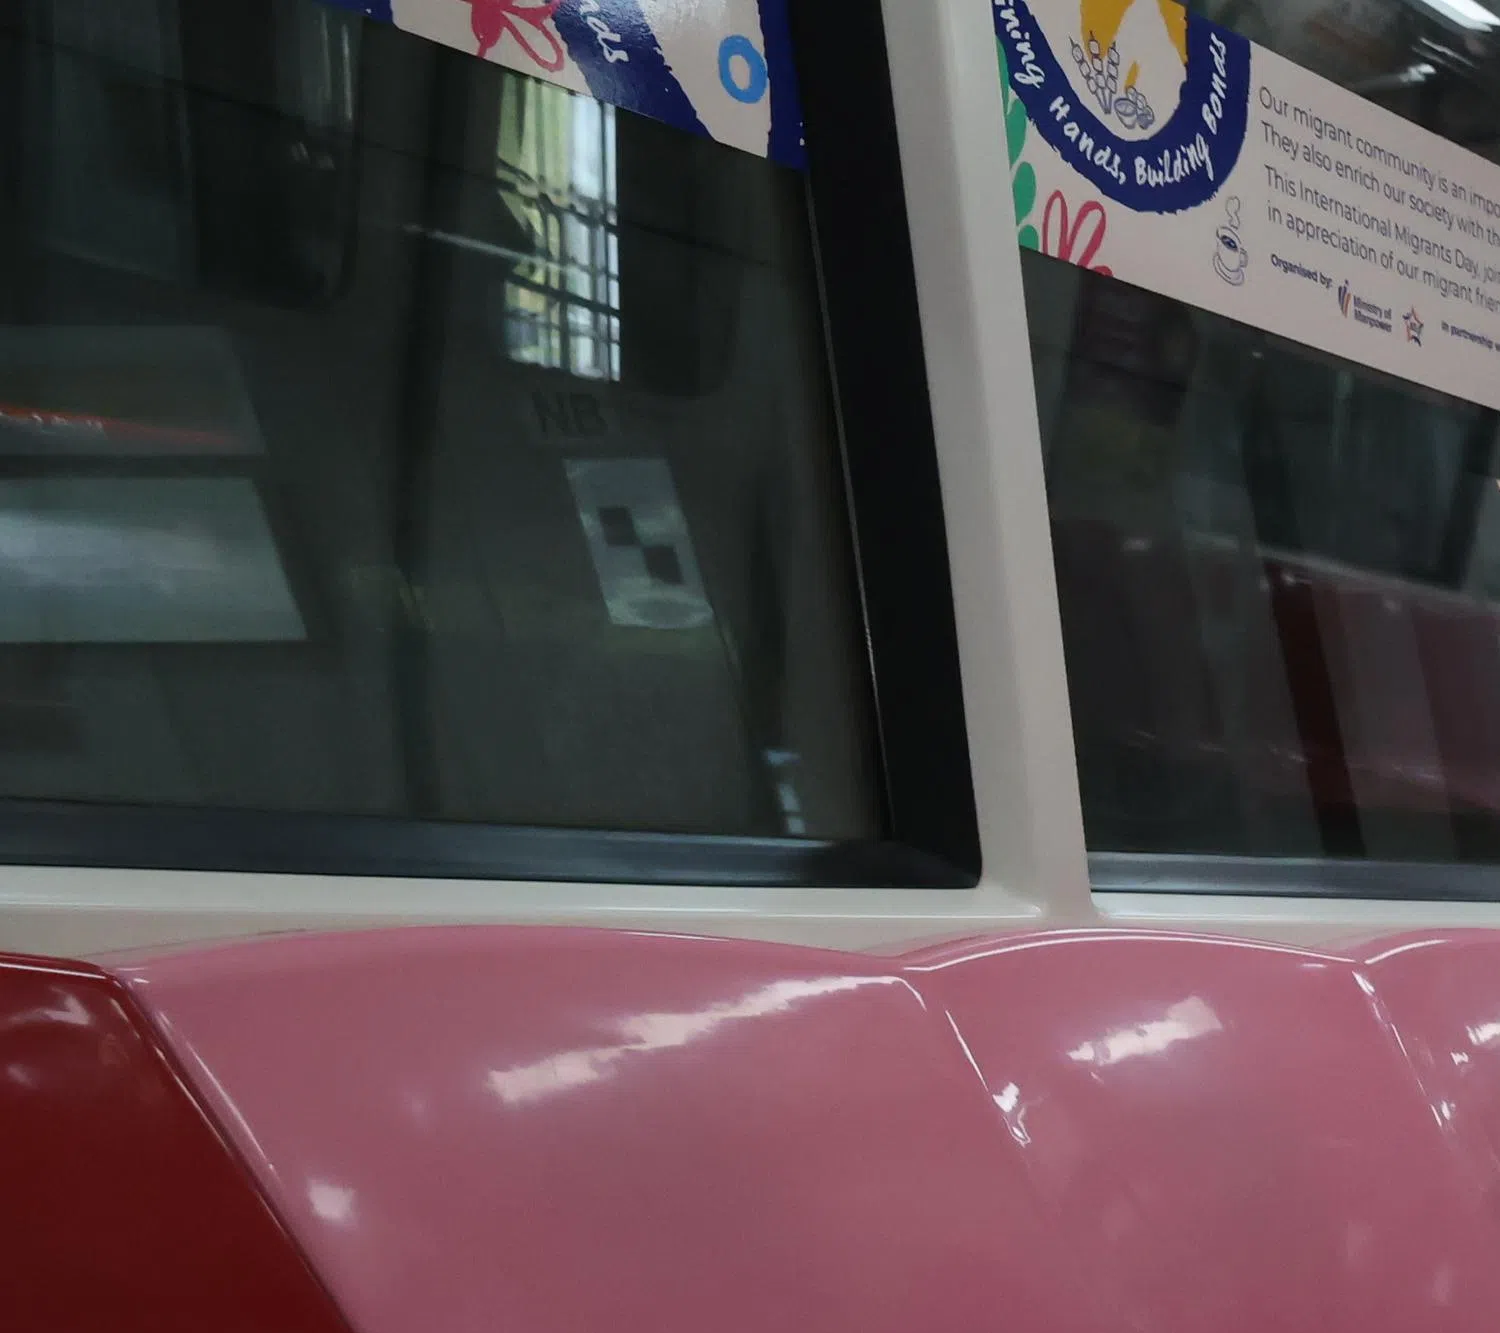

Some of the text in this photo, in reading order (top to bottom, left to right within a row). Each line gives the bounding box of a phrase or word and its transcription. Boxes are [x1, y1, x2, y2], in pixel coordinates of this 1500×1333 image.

[1050, 96, 1126, 185] Hands,
[1134, 133, 1214, 188] Building
[1202, 32, 1227, 135] Bonds
[1259, 86, 1289, 117] Our
[1293, 107, 1353, 149] migrant
[1356, 137, 1435, 191] community
[1438, 176, 1449, 194] is
[1451, 182, 1467, 201] an
[1261, 120, 1299, 161] They
[1302, 144, 1332, 172] also
[1336, 161, 1380, 193] enrich
[1383, 183, 1406, 205] our
[1409, 193, 1455, 231] society
[1457, 216, 1484, 240] with
[1264, 164, 1296, 198] This
[1300, 180, 1392, 237] International
[1394, 223, 1452, 264] Migrants
[1267, 200, 1283, 223] in
[1287, 211, 1377, 264] appreciation
[1380, 250, 1394, 269] of
[1397, 259, 1420, 280] our
[1423, 269, 1473, 303] migrant
[1271, 253, 1318, 284] Organised
